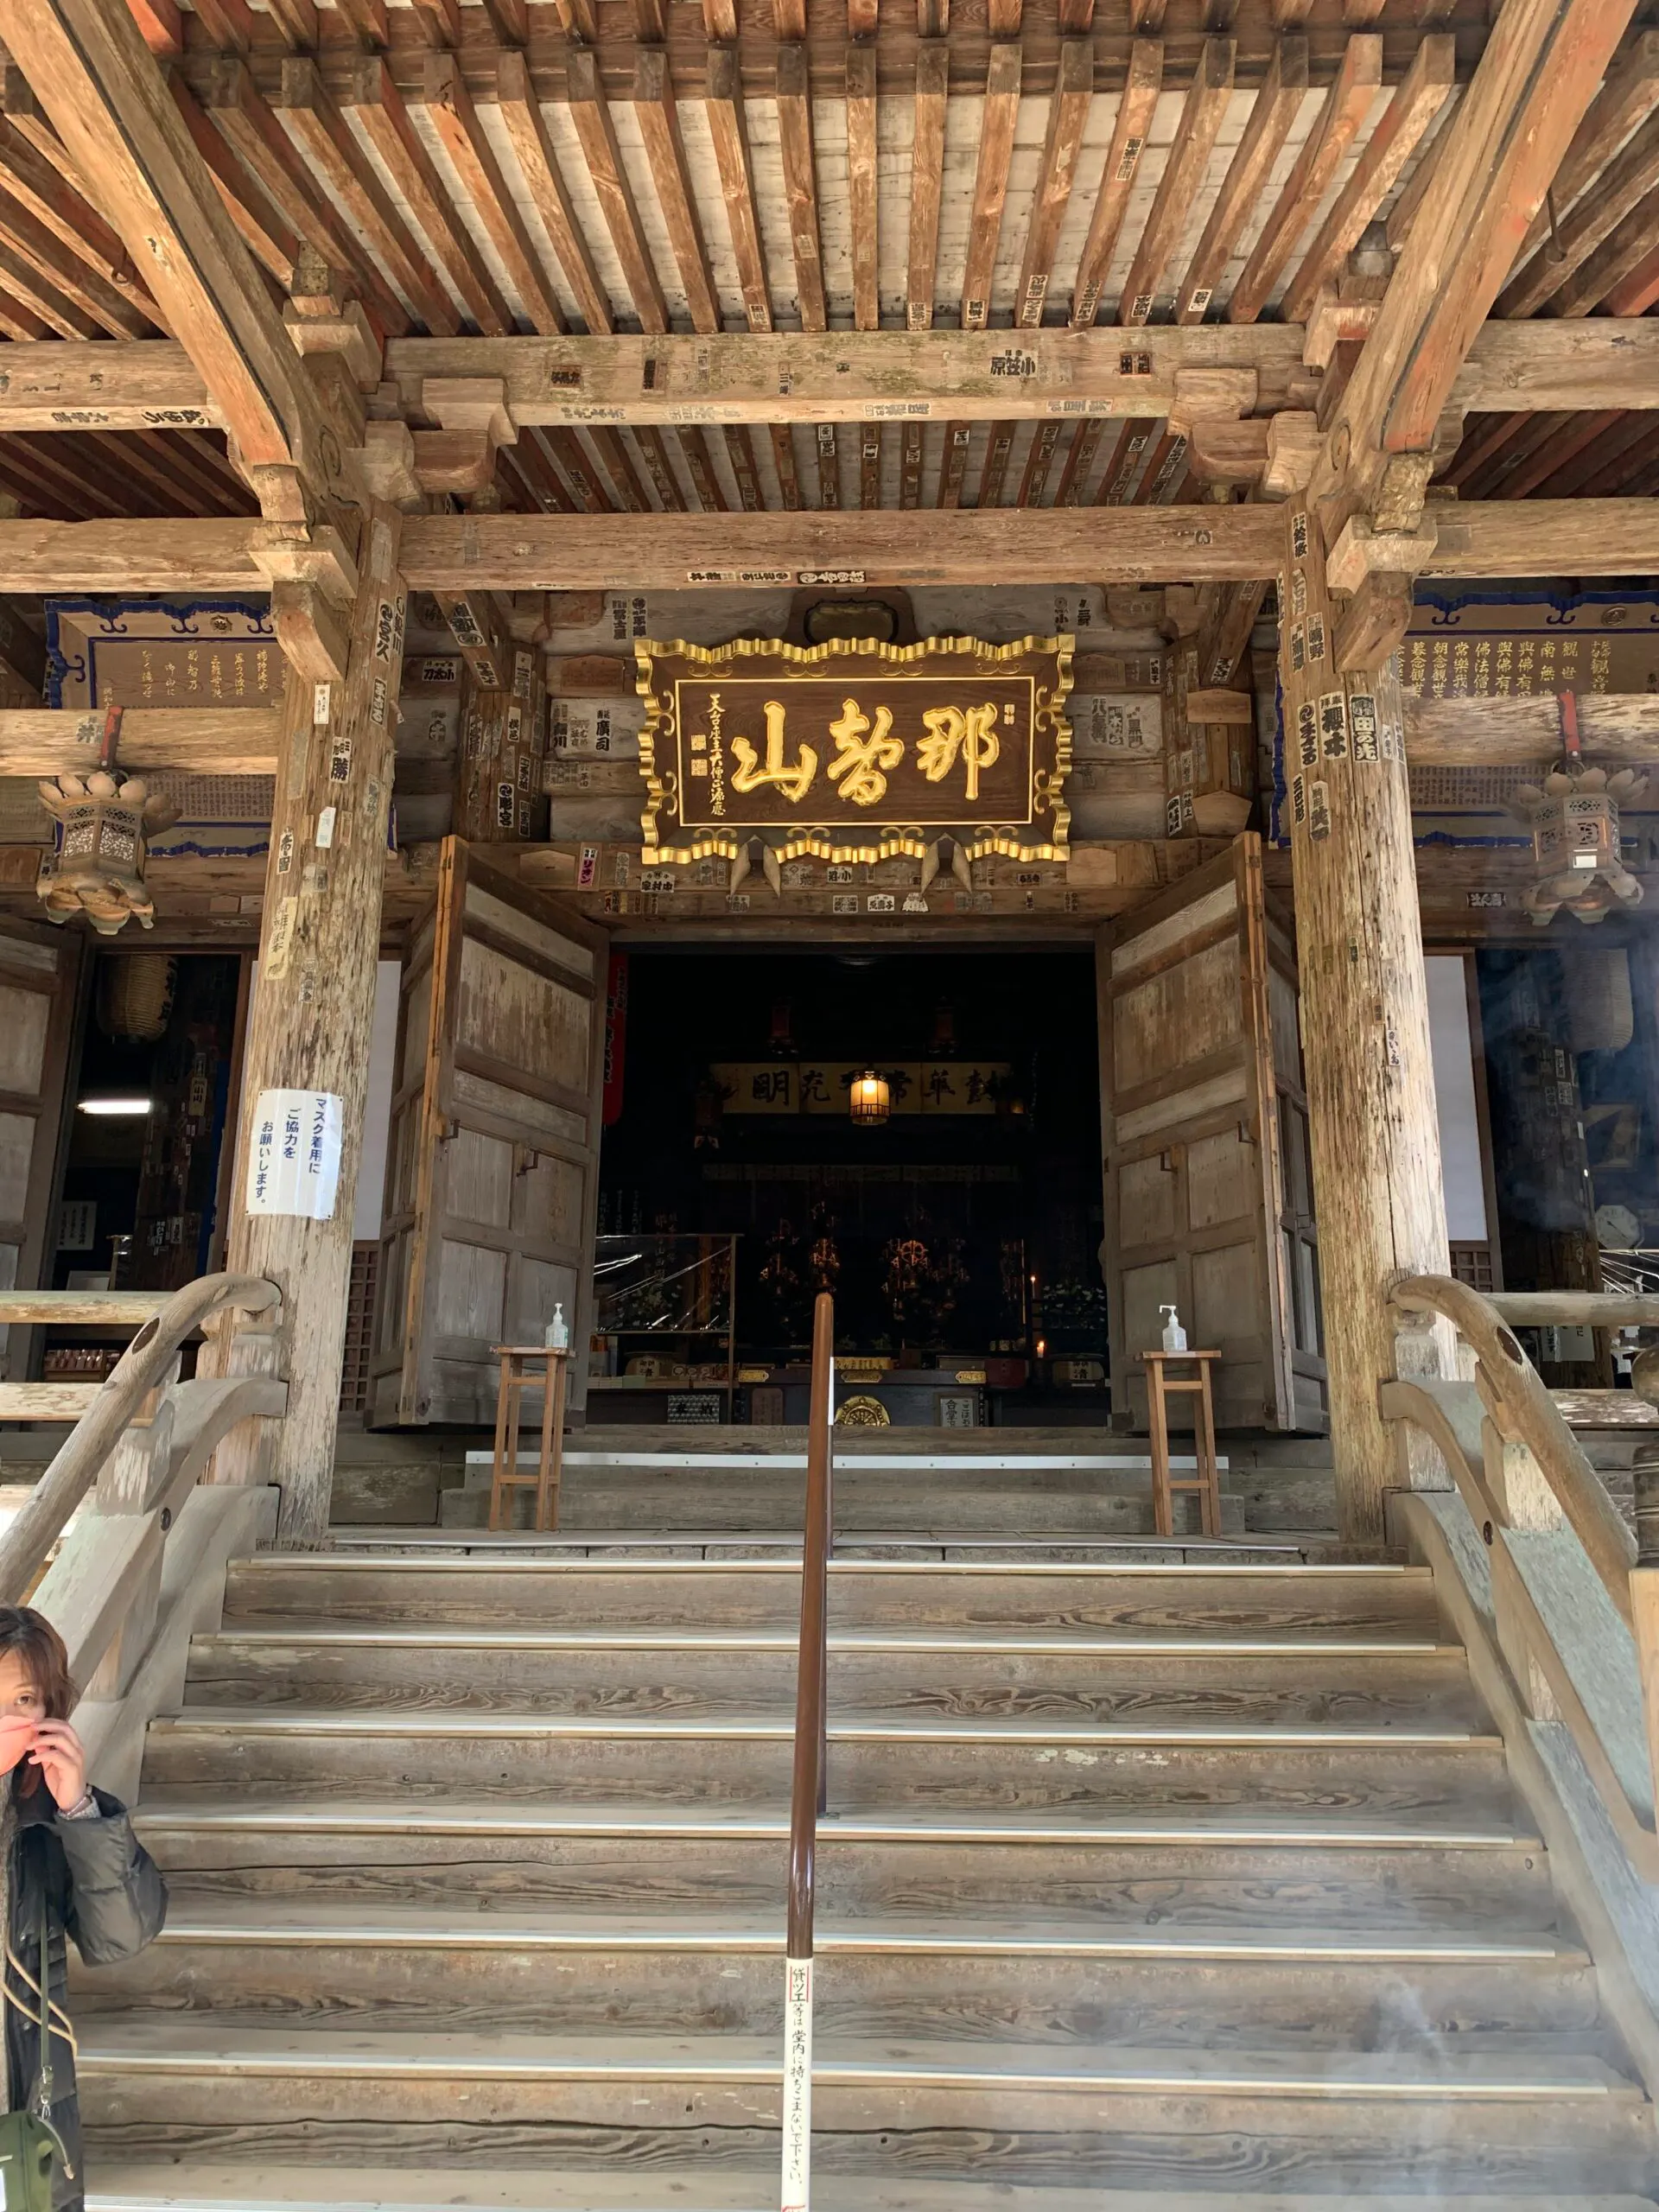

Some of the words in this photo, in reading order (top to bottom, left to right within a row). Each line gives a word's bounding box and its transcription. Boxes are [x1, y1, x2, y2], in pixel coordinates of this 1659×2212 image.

[256, 1121, 274, 1204] お願いします。
[283, 1108, 302, 1160] ご協力を
[308, 1097, 327, 1174] マスク着用に
